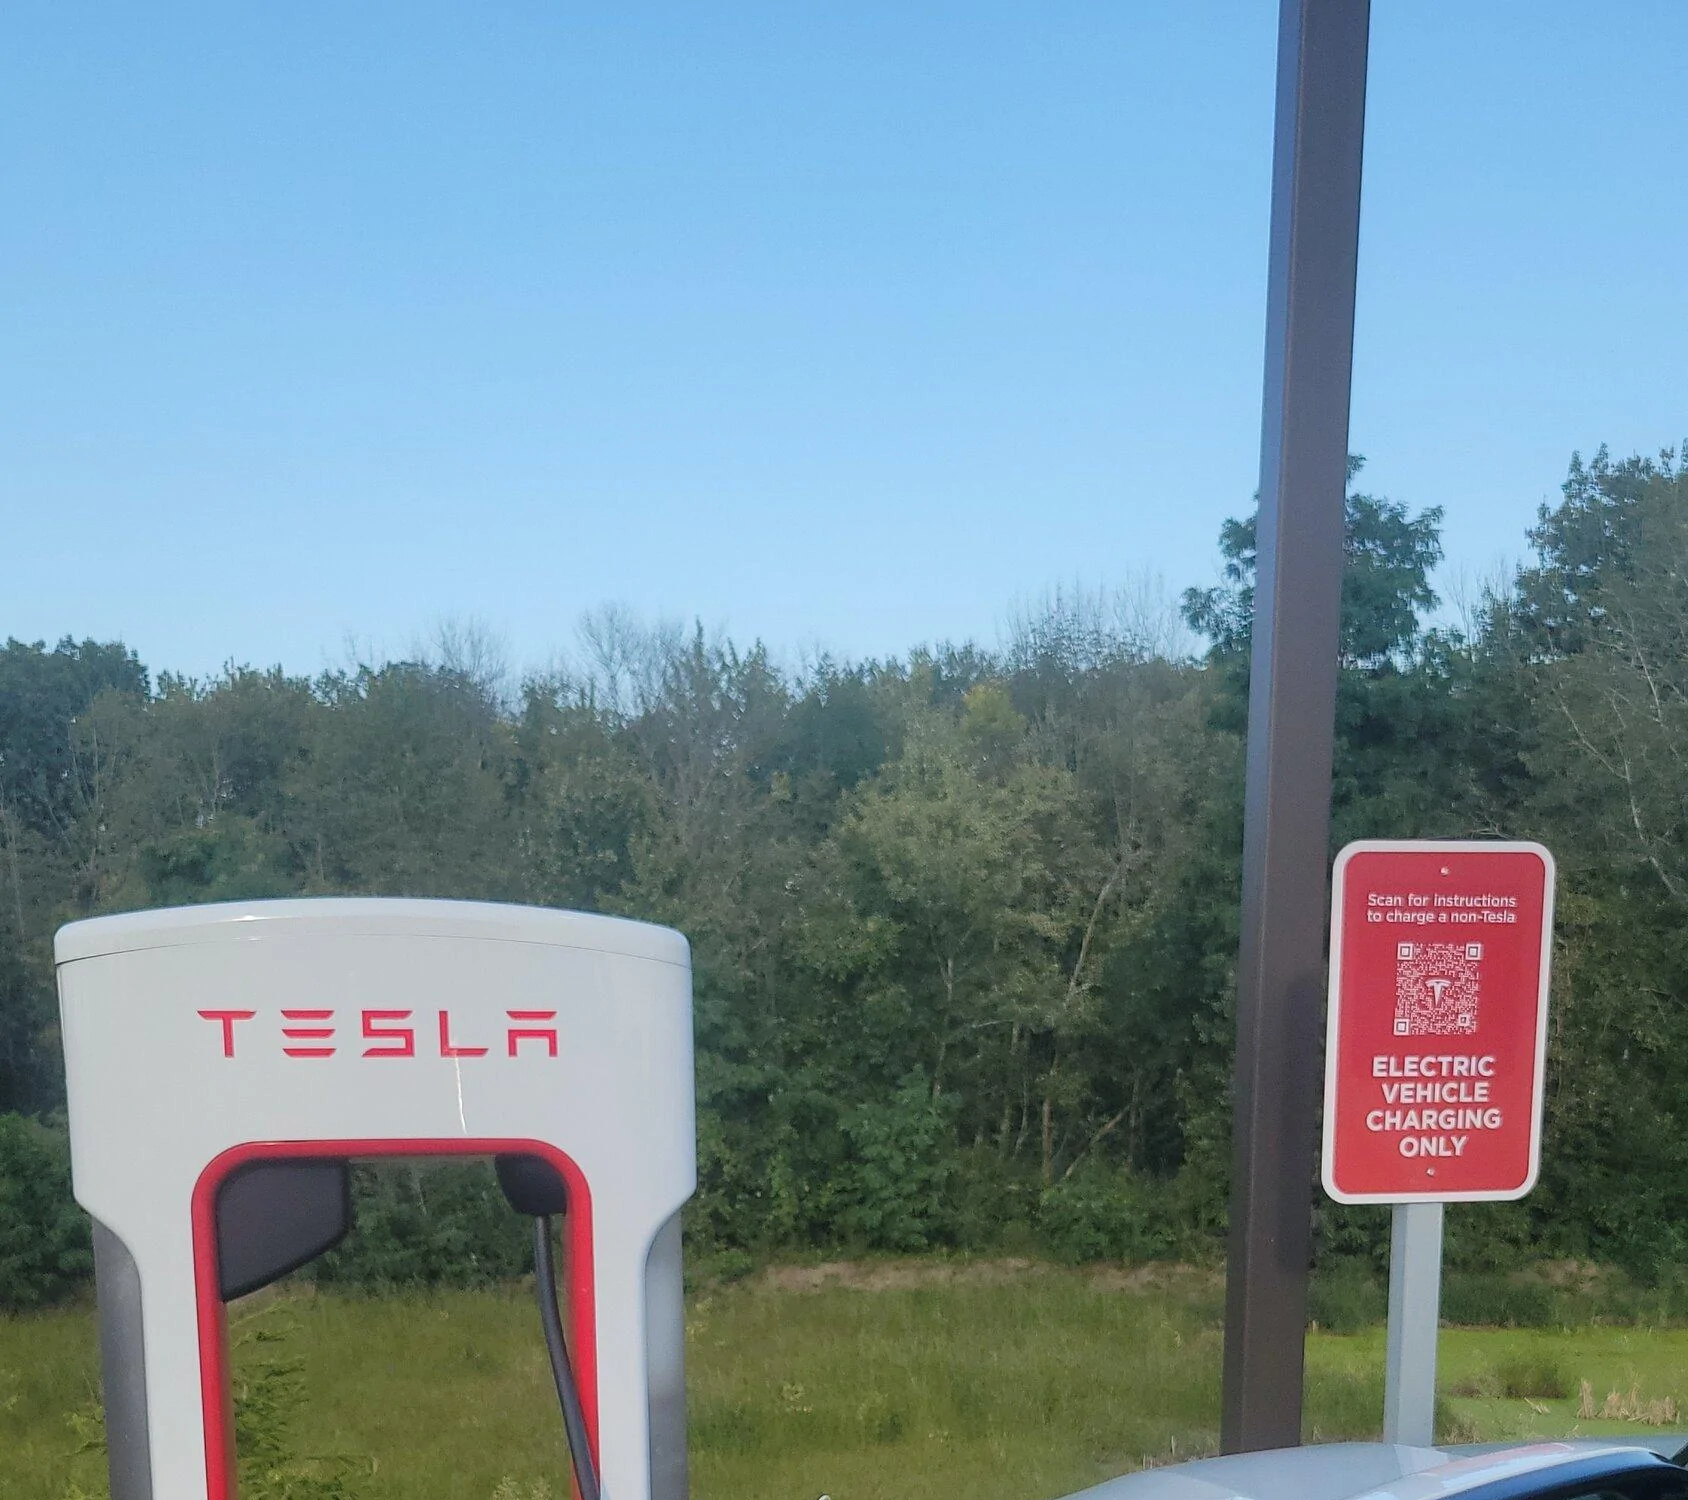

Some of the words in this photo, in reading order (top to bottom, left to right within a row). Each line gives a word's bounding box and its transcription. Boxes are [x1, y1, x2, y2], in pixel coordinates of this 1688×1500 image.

[1367, 893, 1401, 907] Scan
[1408, 893, 1429, 907] for
[1433, 893, 1516, 907] instructions
[1366, 909, 1381, 923] to
[1386, 908, 1435, 925] charge
[1438, 913, 1447, 923] a
[1451, 909, 1516, 923] non-Tesla
[197, 1009, 558, 1058] TESLA
[1372, 1055, 1496, 1078] ELECTRIC
[1381, 1081, 1490, 1104] VEHICLE
[1366, 1108, 1502, 1132] CHARGING
[1399, 1135, 1468, 1158] ONLY
